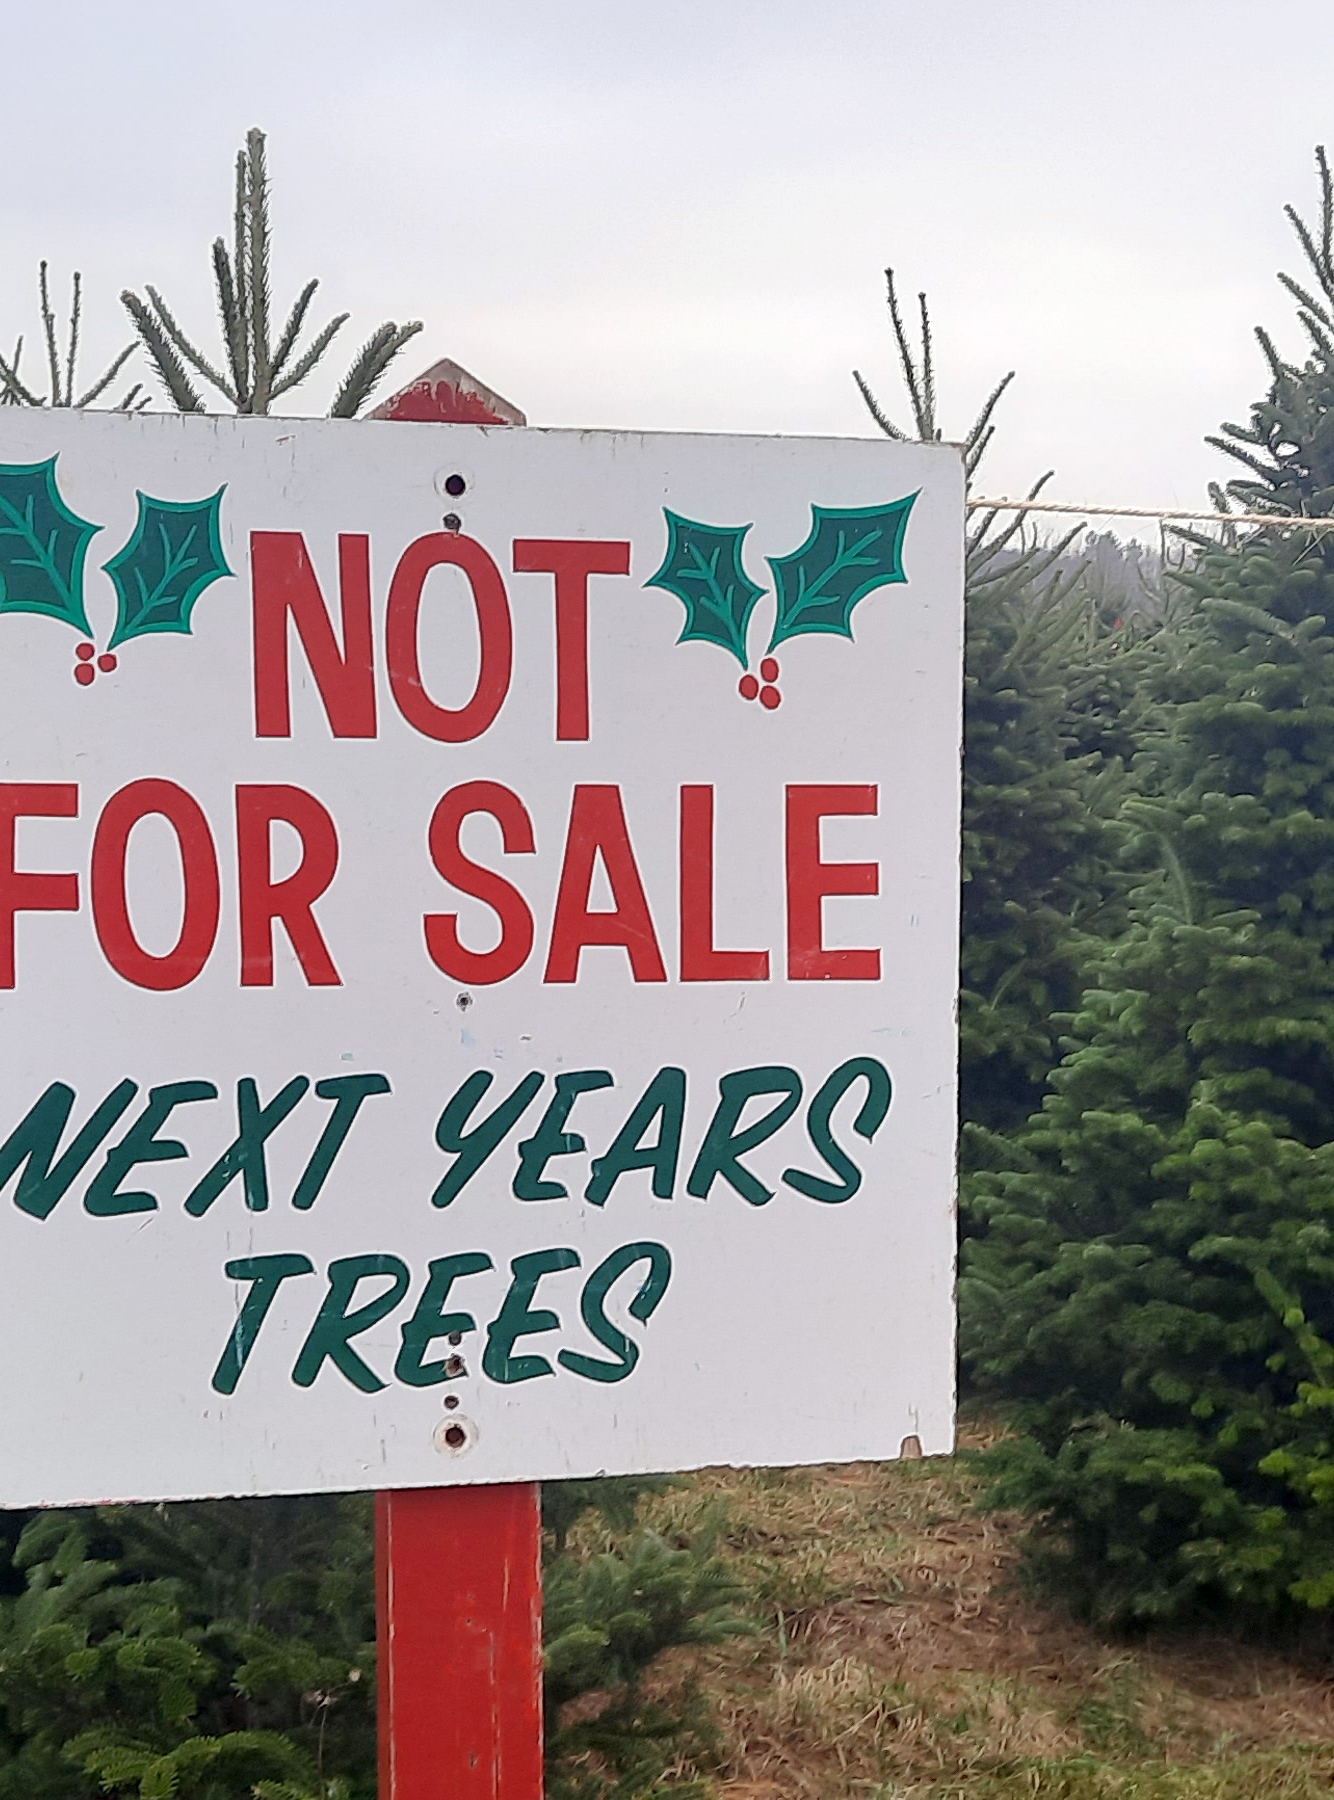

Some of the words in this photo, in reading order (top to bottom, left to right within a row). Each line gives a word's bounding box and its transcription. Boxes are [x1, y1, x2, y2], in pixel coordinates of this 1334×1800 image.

[251, 531, 630, 743] NOT
[424, 780, 881, 985] SALE
[433, 1058, 892, 1208] YEARS
[212, 1242, 672, 1395] TREES
